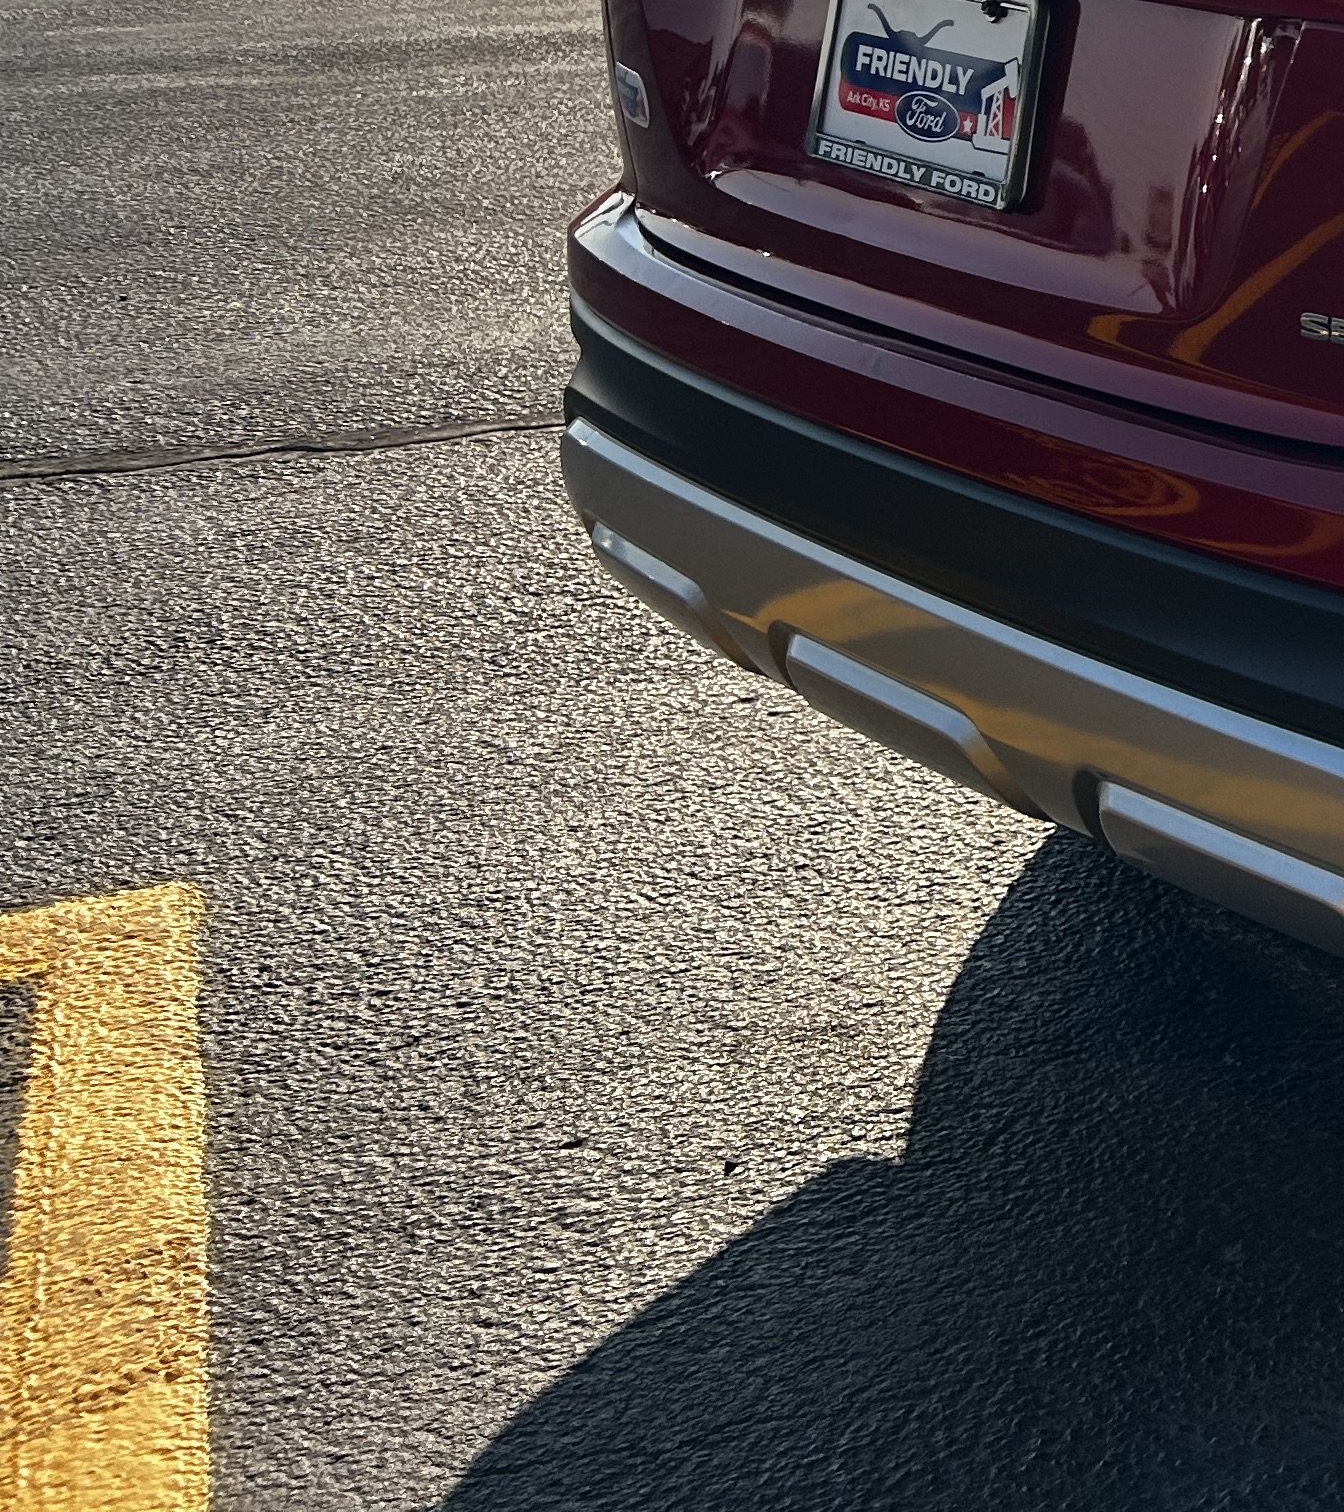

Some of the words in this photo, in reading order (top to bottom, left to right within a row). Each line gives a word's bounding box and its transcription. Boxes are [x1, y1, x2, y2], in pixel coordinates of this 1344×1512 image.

[855, 44, 975, 96] FRIENDLY
[846, 90, 861, 103] Ark
[879, 97, 891, 112] KS
[905, 96, 947, 133] Ford
[818, 140, 927, 183] FRIENDLY
[930, 170, 996, 203] FORD
